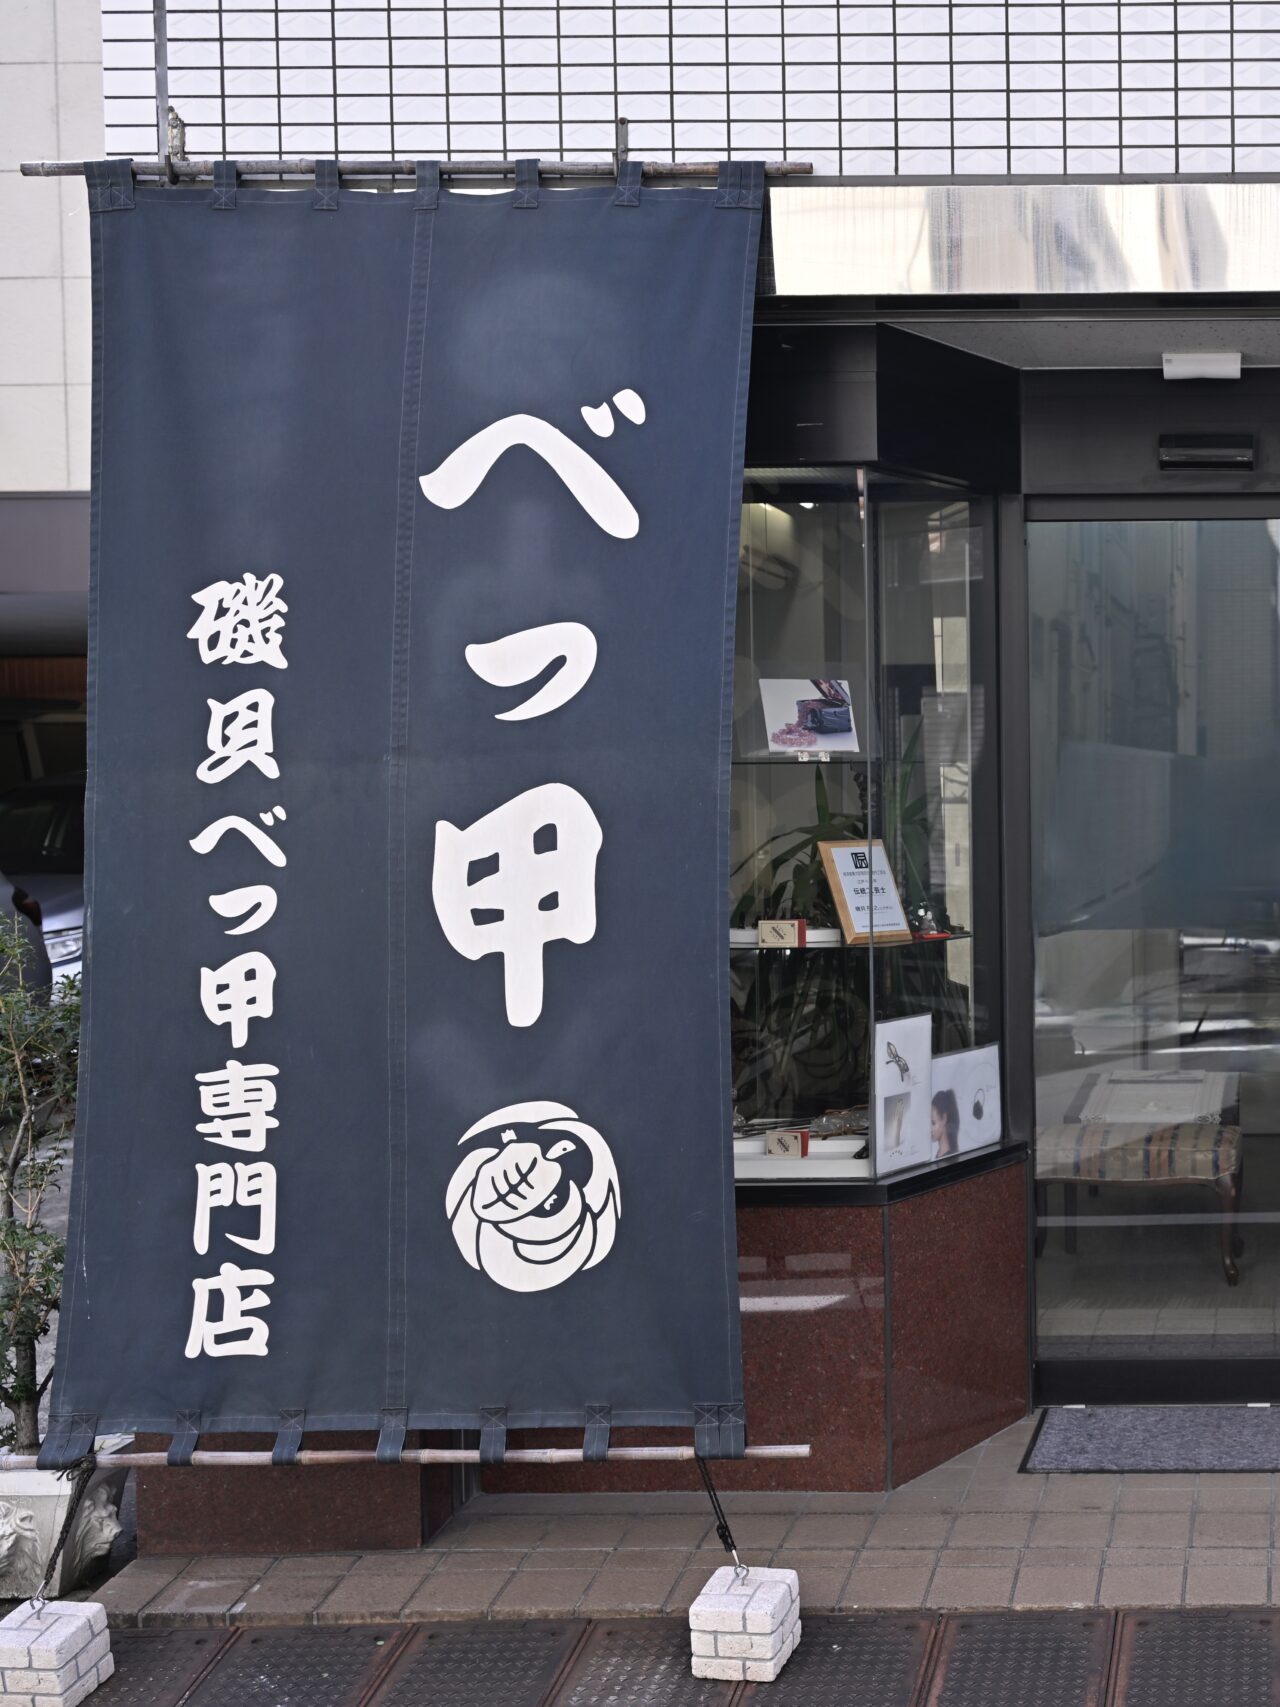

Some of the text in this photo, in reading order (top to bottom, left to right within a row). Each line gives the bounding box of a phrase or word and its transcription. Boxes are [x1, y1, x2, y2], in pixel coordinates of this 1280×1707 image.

[185, 572, 288, 1358] 磯貝べっ甲専門店
[419, 388, 645, 1027] べっ甲
